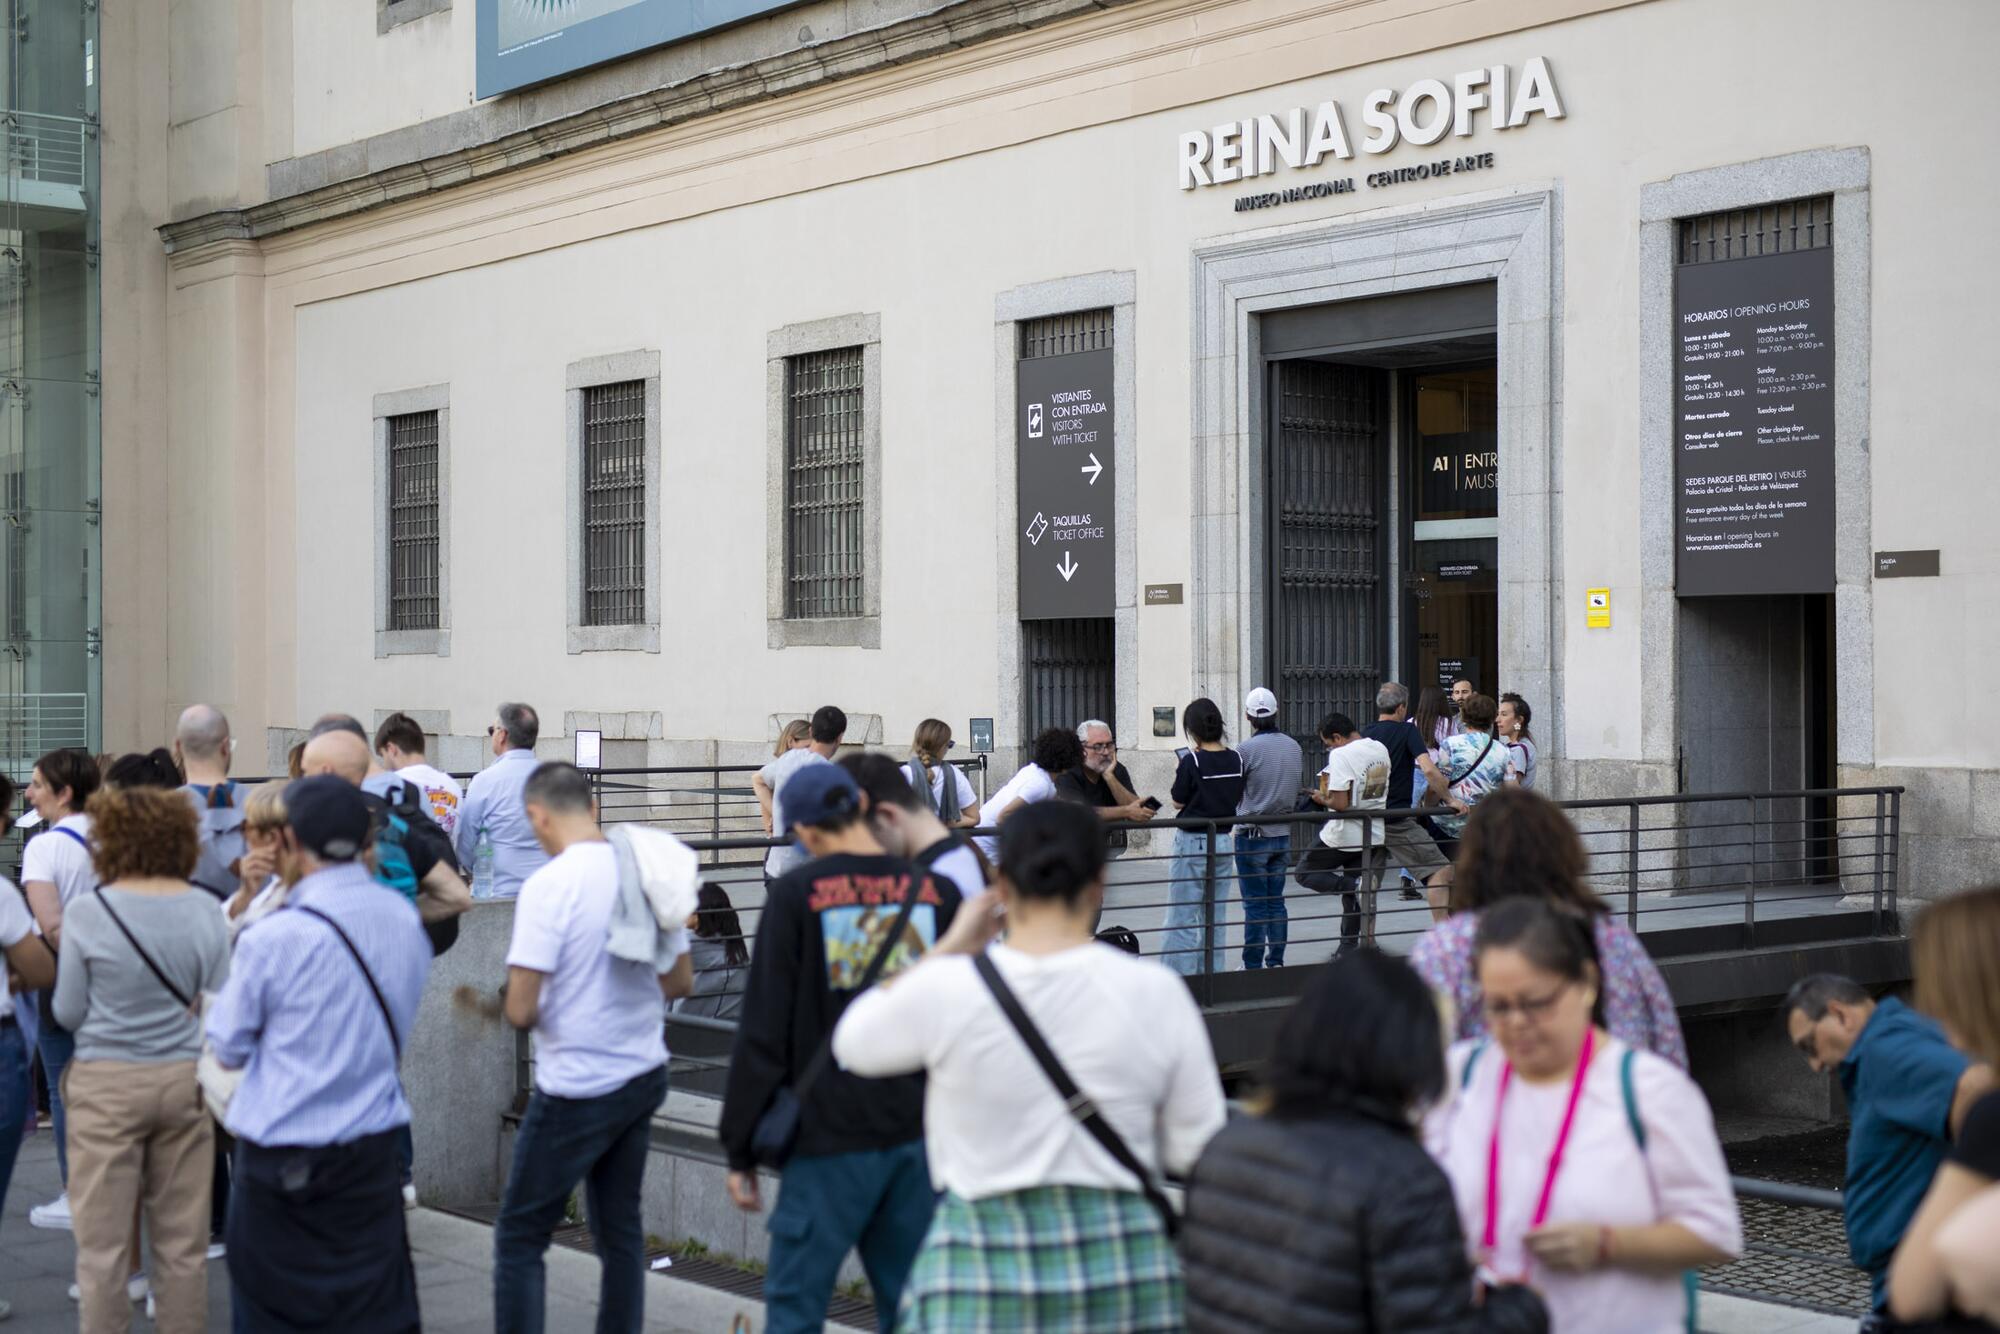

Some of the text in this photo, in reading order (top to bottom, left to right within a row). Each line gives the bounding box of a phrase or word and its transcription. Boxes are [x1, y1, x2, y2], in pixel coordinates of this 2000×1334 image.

[1179, 56, 1566, 190] REINA SOFIA
[1235, 152, 1494, 212] MUSEO NACIONAL CENTRO DE ARTE
[1684, 309, 1728, 323] HORARIOS
[1735, 303, 1777, 317] OPENING
[1779, 299, 1810, 311] HOURS
[1757, 325, 1778, 334] Monday
[1785, 322, 1808, 331] Saturday
[1704, 342, 1719, 350] 21:00
[1725, 350, 1740, 358] 21:00
[1757, 366, 1776, 374] Sunday
[1052, 390, 1092, 404] VISITANTES
[1741, 388, 1745, 396] h
[1052, 402, 1107, 418] CON ENTRADA
[1707, 411, 1730, 419] cerrado
[1052, 419, 1083, 432] VISITORS
[1792, 424, 1804, 432] days
[1052, 431, 1098, 445] WITH TICKET
[1432, 456, 1448, 472] A1
[1686, 478, 1706, 486] SEDES
[1708, 475, 1734, 485] PARQUE
[1736, 474, 1747, 483] DEL
[1749, 473, 1773, 482] RETIRO
[1779, 470, 1807, 479] VENUES
[1715, 485, 1734, 493] Cristal
[1739, 484, 1759, 492] Palacio
[1706, 505, 1728, 514] gratuito
[1729, 504, 1744, 512] todos
[1746, 503, 1754, 511] los
[1053, 514, 1092, 527] TAQUILLAS
[1740, 514, 1751, 522] day
[1053, 527, 1104, 541] TICKET OFFICE
[1686, 534, 1713, 542] Horarios
[1727, 532, 1753, 541] opening
[1754, 531, 1771, 539] hours
